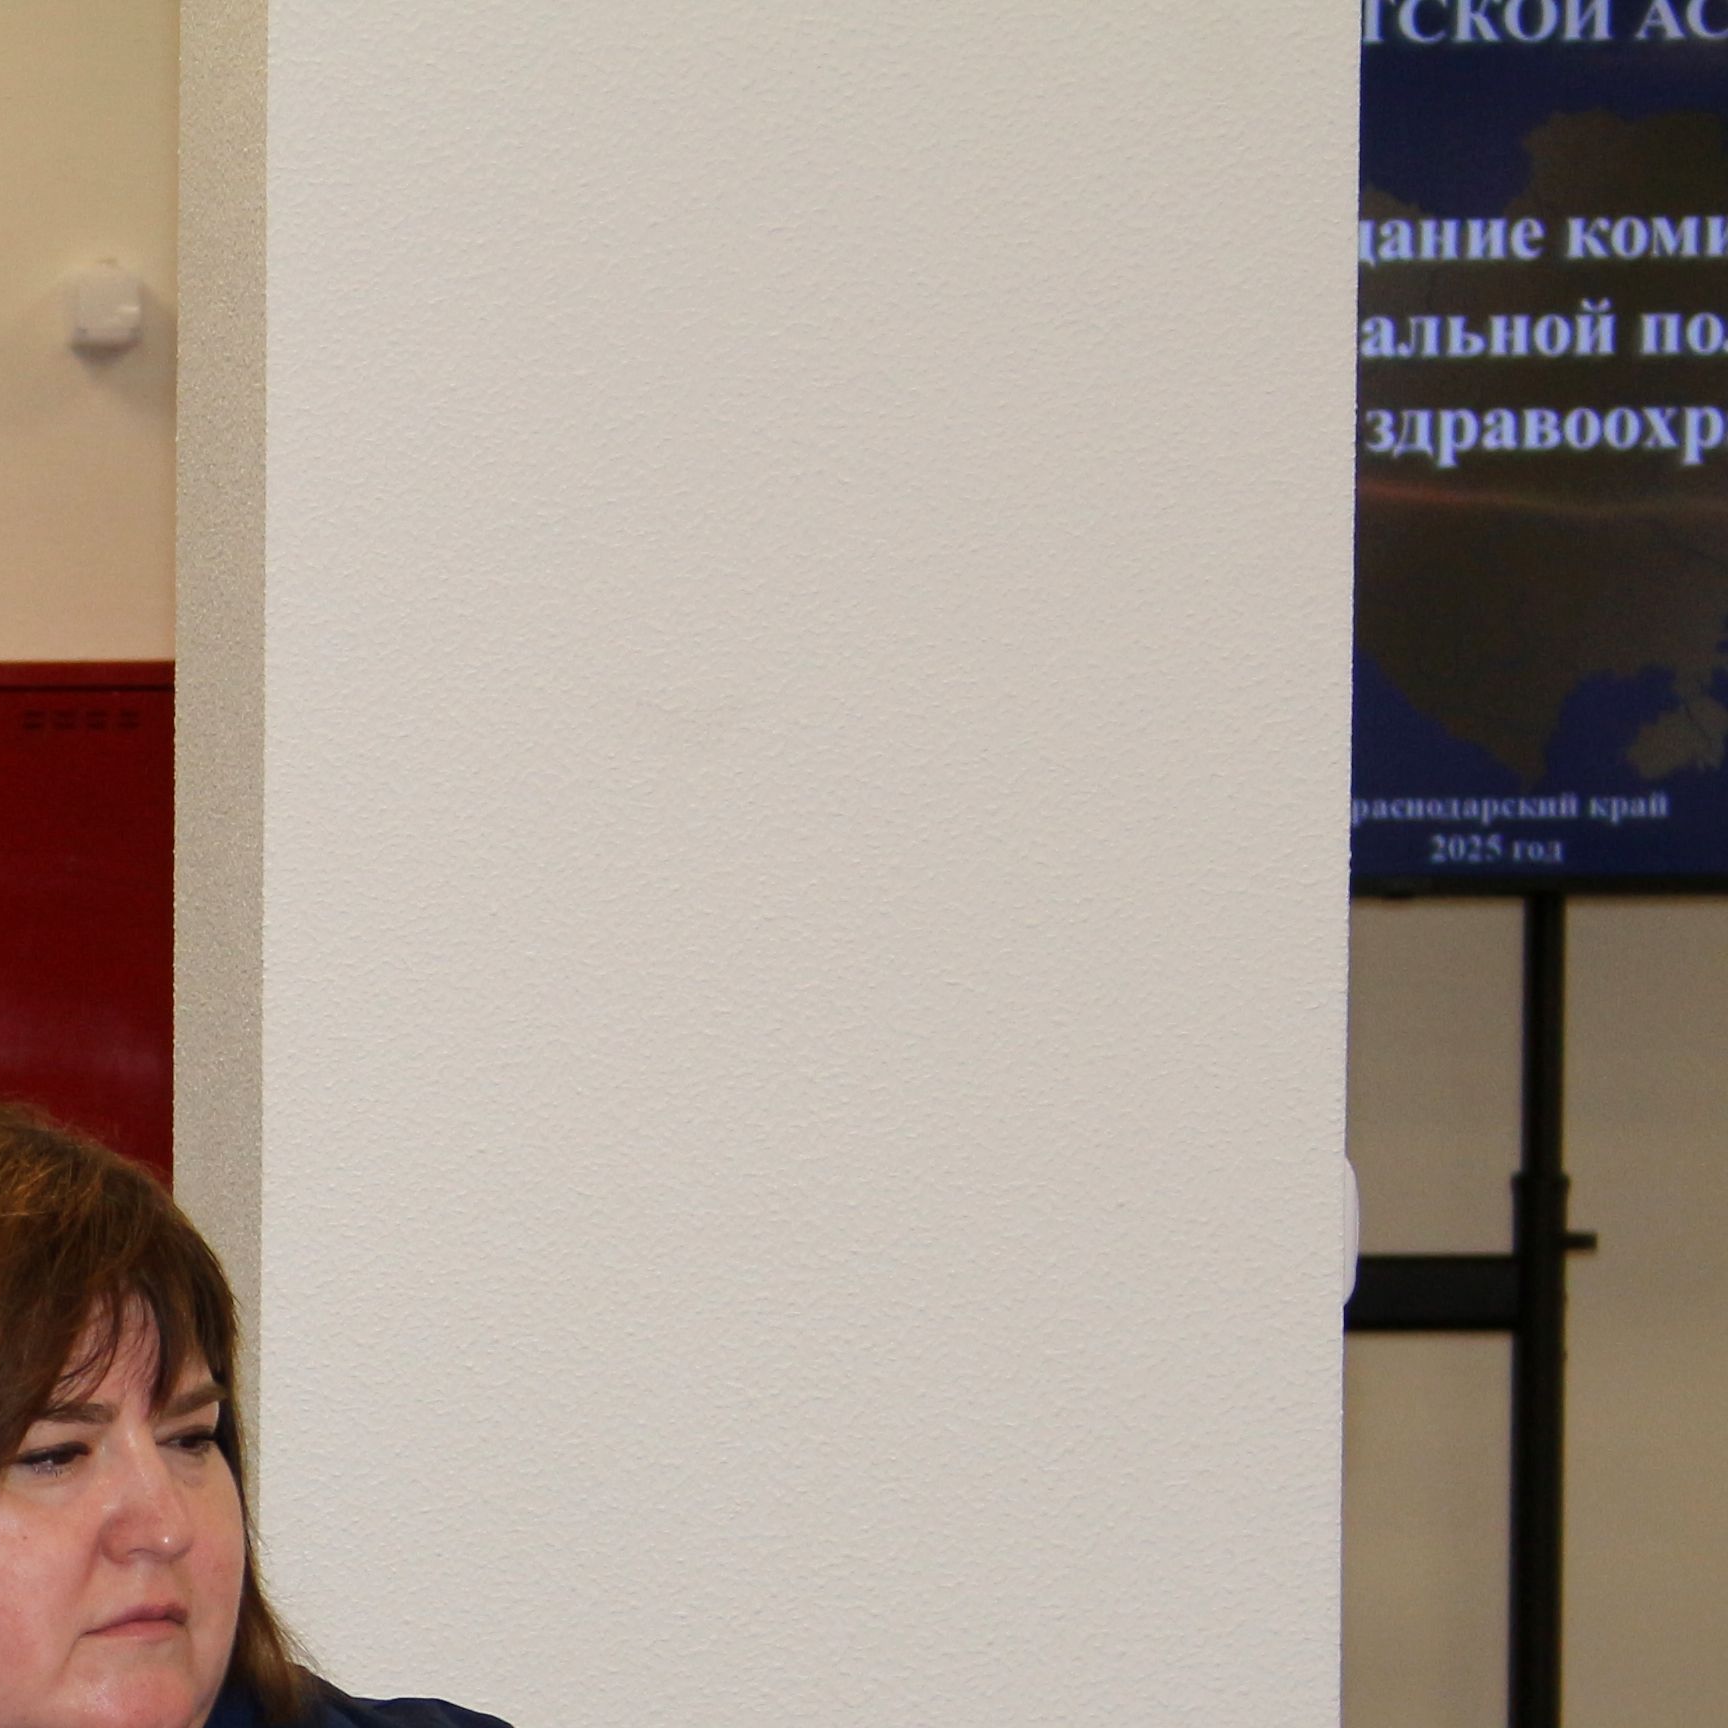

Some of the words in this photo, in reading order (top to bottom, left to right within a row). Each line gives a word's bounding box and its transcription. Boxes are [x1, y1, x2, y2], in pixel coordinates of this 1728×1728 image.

[1359, 298, 1616, 358] альной
[1639, 311, 1728, 357] по
[1365, 406, 1728, 468] здравоохр
[1588, 791, 1670, 824] край
[1430, 833, 1502, 863] 2025
[1512, 838, 1565, 863] год
